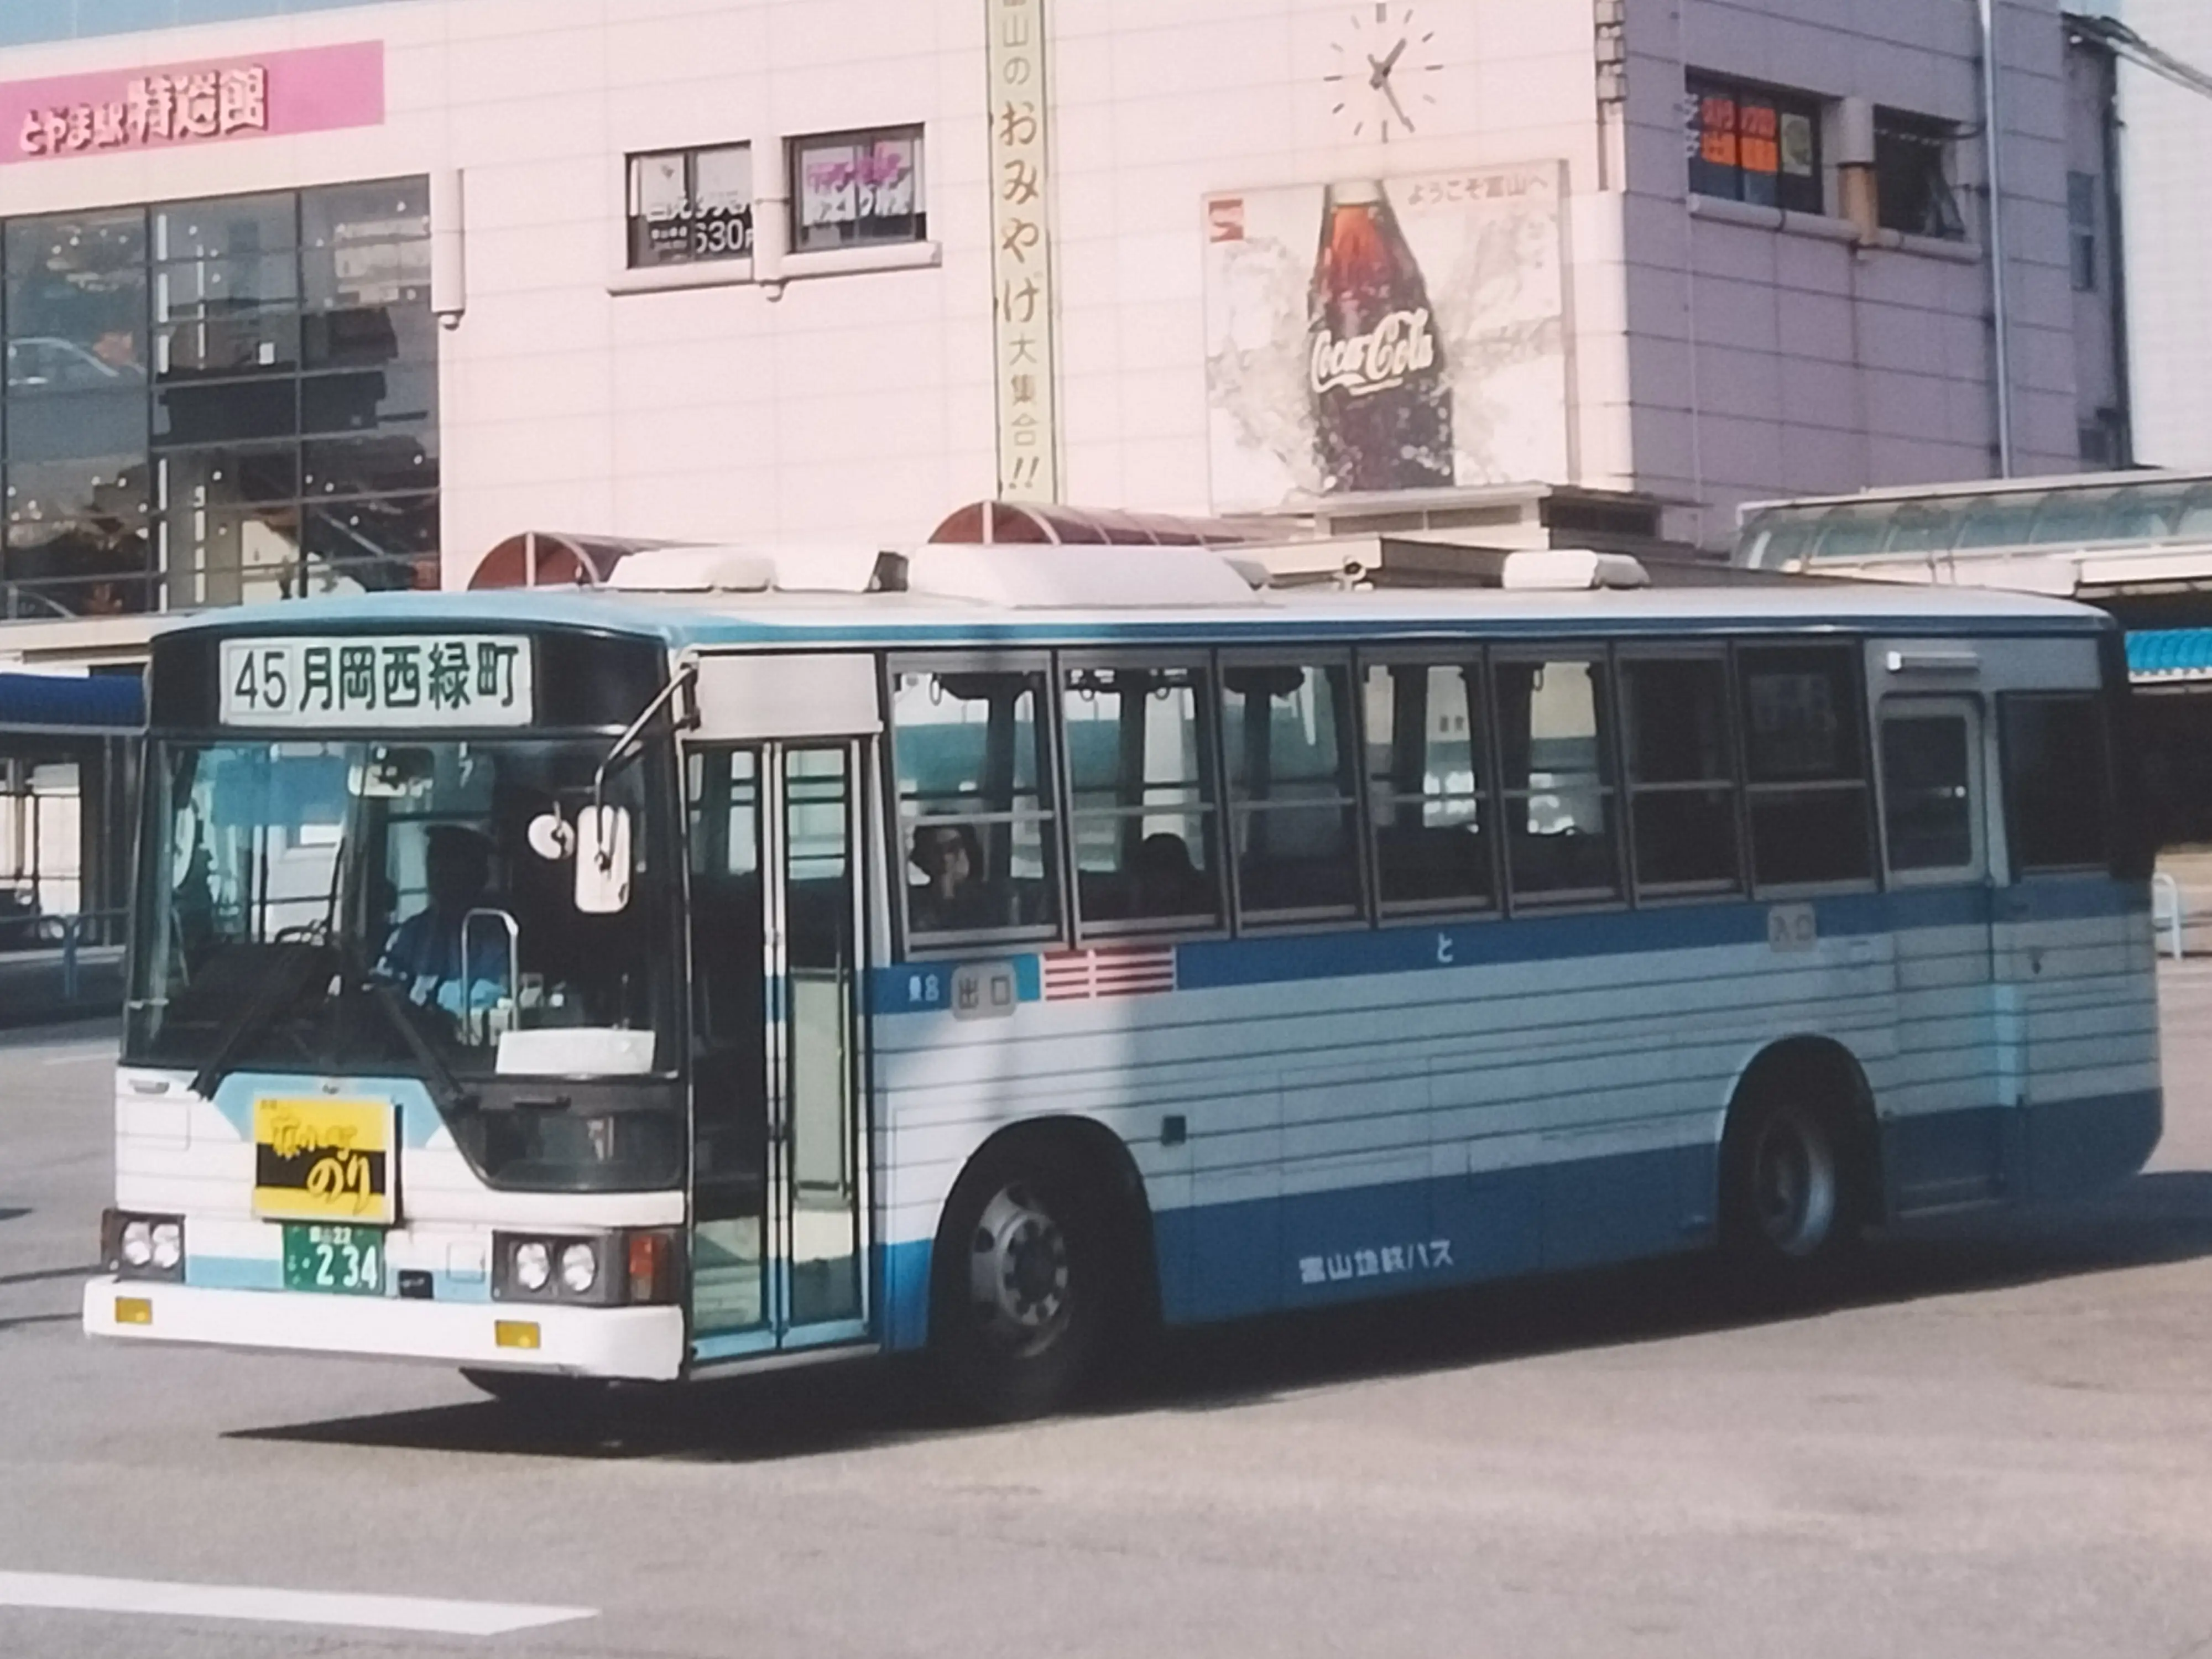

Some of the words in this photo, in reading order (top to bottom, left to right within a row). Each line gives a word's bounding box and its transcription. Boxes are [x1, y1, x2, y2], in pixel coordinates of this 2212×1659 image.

[234, 650, 287, 710] 45
[299, 641, 519, 712] 月岡西緑町
[1437, 932, 1454, 963] と
[959, 975, 1011, 1010] 出口
